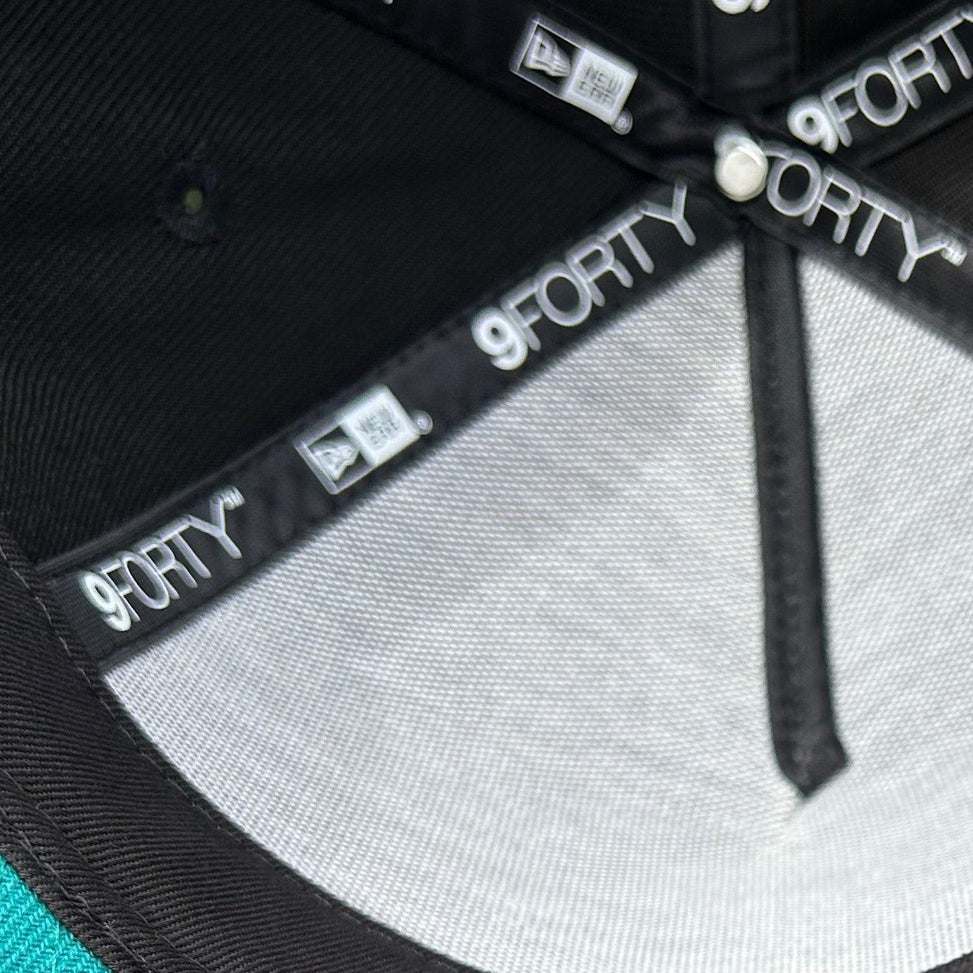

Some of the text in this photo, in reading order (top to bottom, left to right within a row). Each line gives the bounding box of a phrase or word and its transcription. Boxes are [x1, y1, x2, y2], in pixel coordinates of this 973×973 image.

[471, 181, 697, 371] 9FORTY
[760, 140, 957, 282] ORTY
[79, 491, 244, 632] 9FORTY
